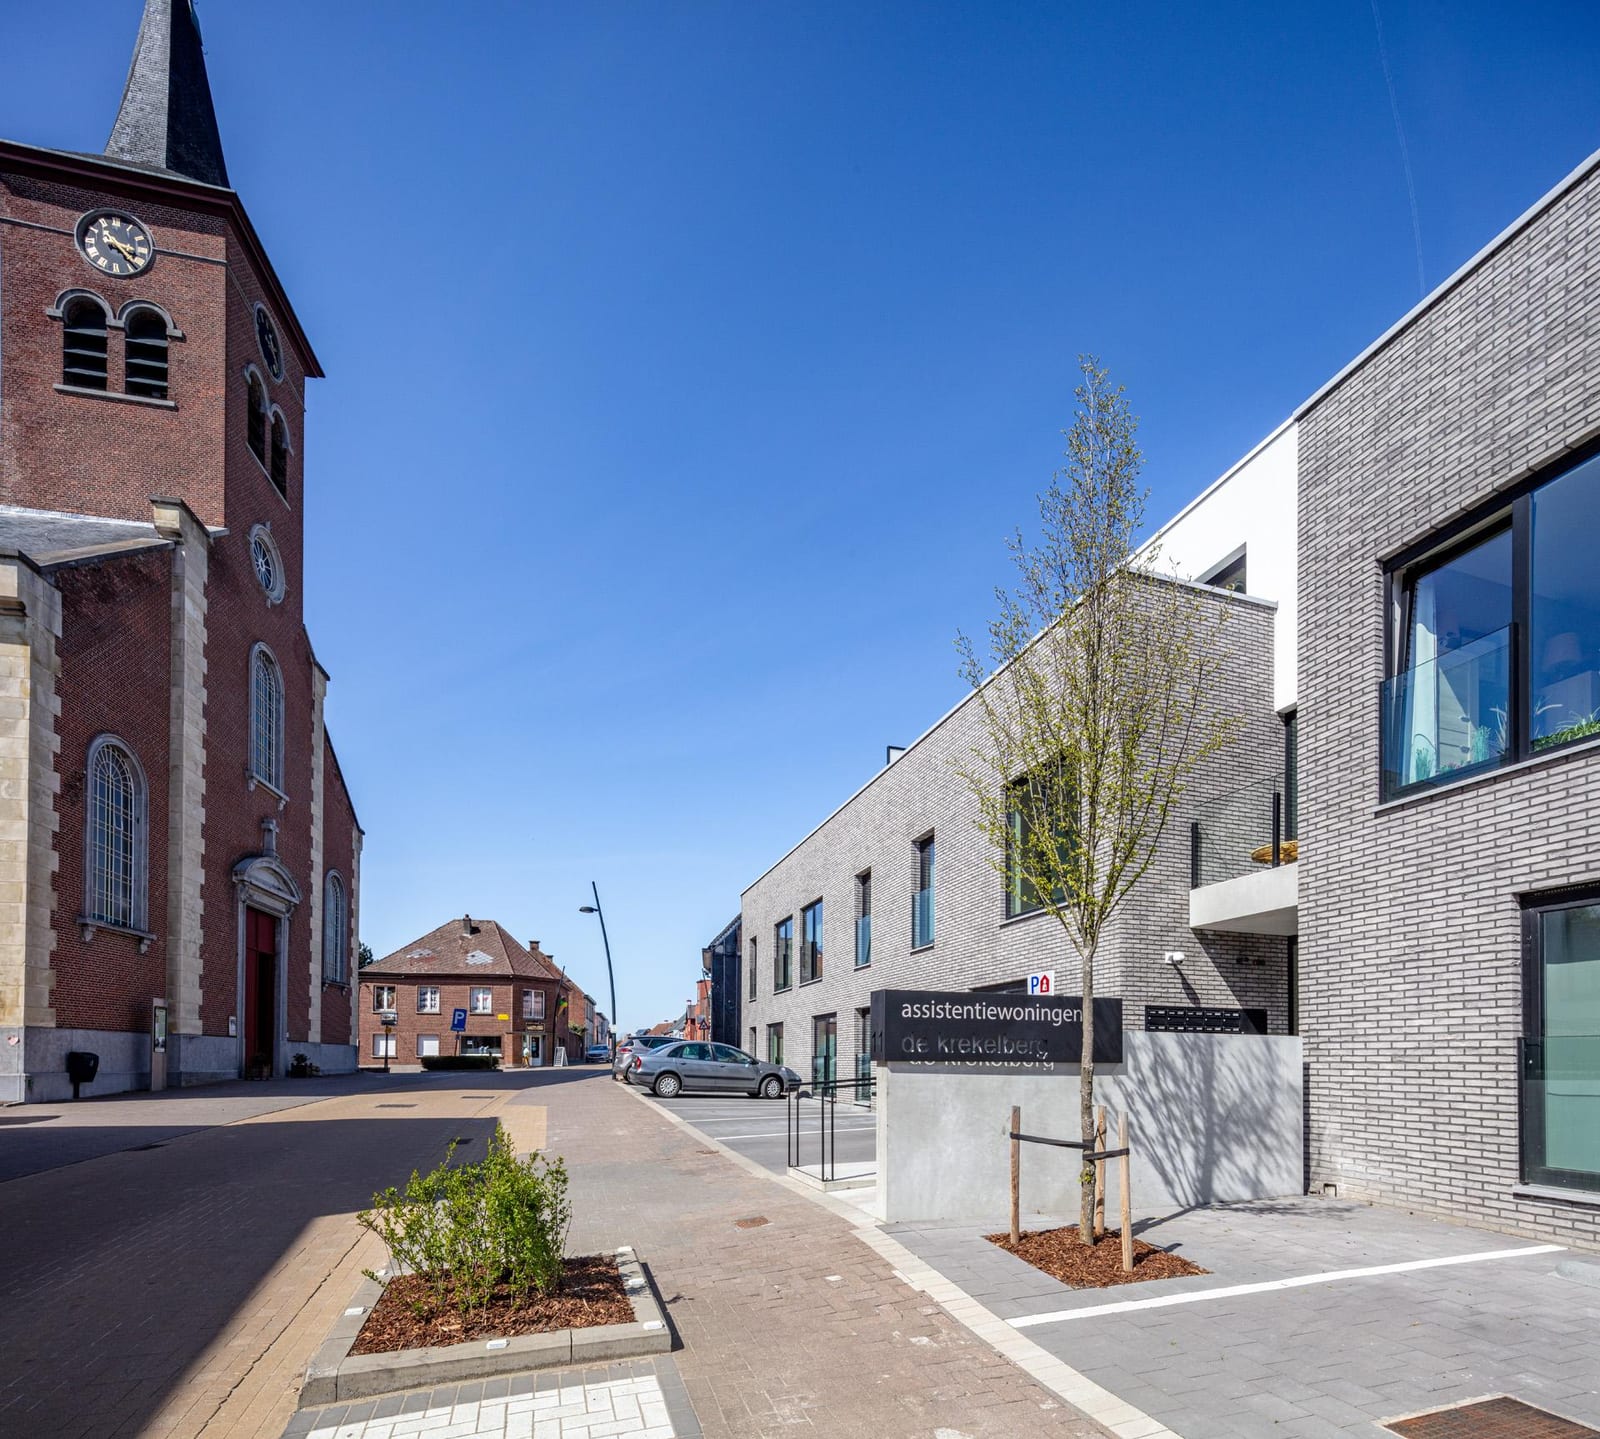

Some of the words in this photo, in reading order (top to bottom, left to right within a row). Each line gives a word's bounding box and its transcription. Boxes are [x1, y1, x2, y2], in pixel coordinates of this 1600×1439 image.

[1031, 976, 1039, 994] P
[454, 1011, 465, 1025] P
[901, 1000, 1083, 1026] assistentiewoningen
[871, 1031, 883, 1053] 11
[901, 1033, 928, 1054] de
[937, 1033, 1049, 1060] krekelberg
